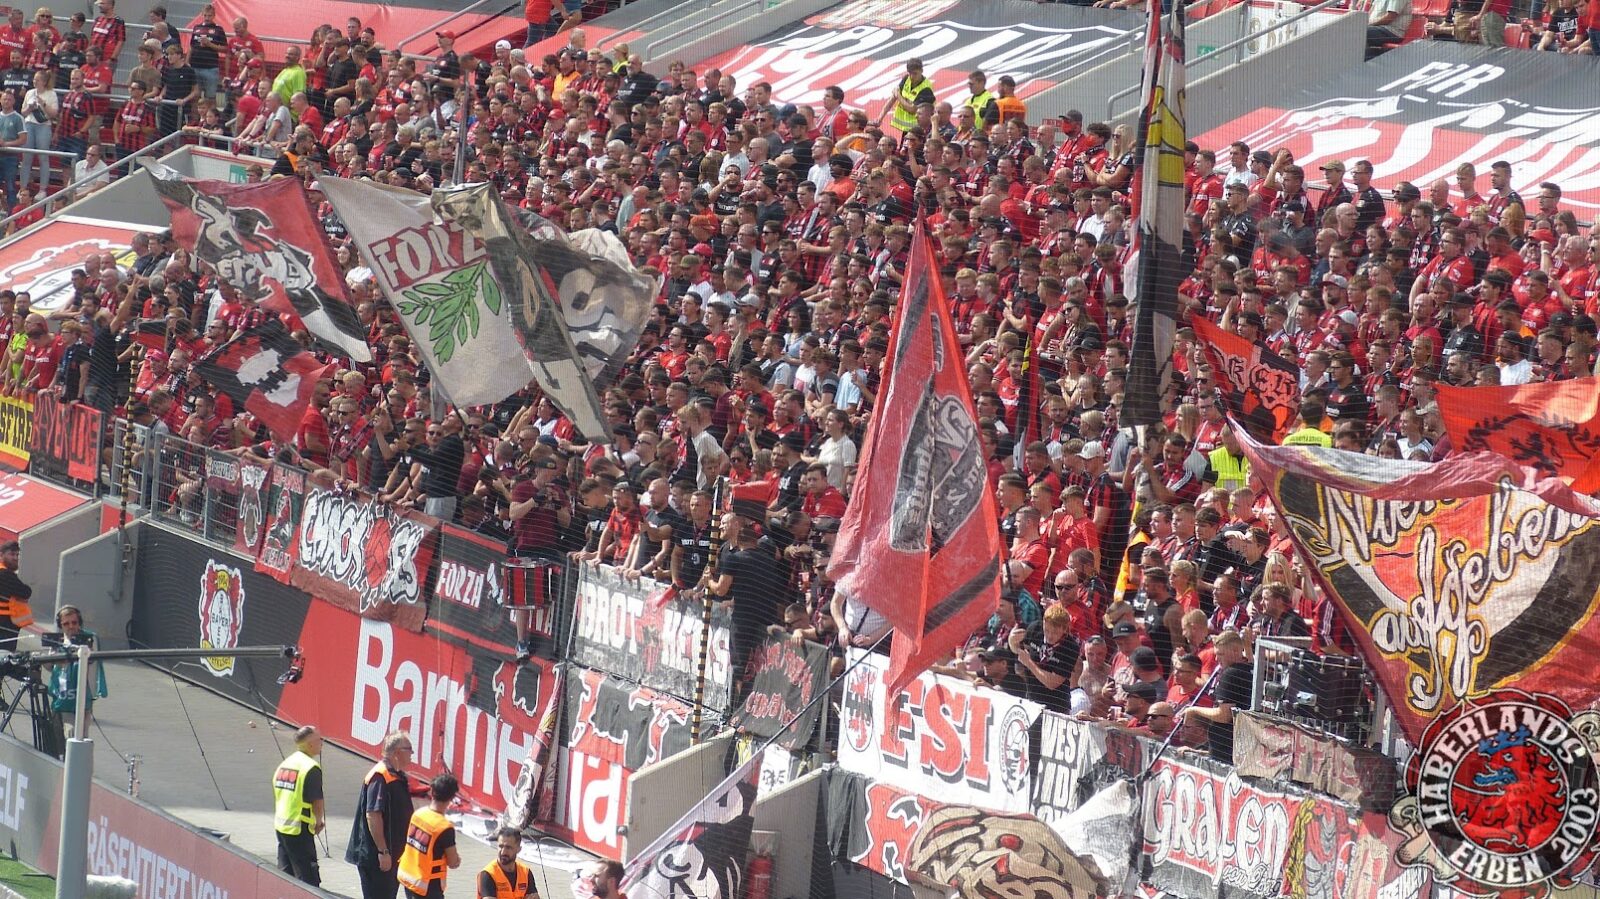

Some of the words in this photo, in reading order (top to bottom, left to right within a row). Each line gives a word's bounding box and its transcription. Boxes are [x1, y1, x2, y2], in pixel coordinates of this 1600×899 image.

[1376, 61, 1506, 98] FÜR
[435, 560, 486, 609] FORZA
[577, 580, 644, 656] BROT
